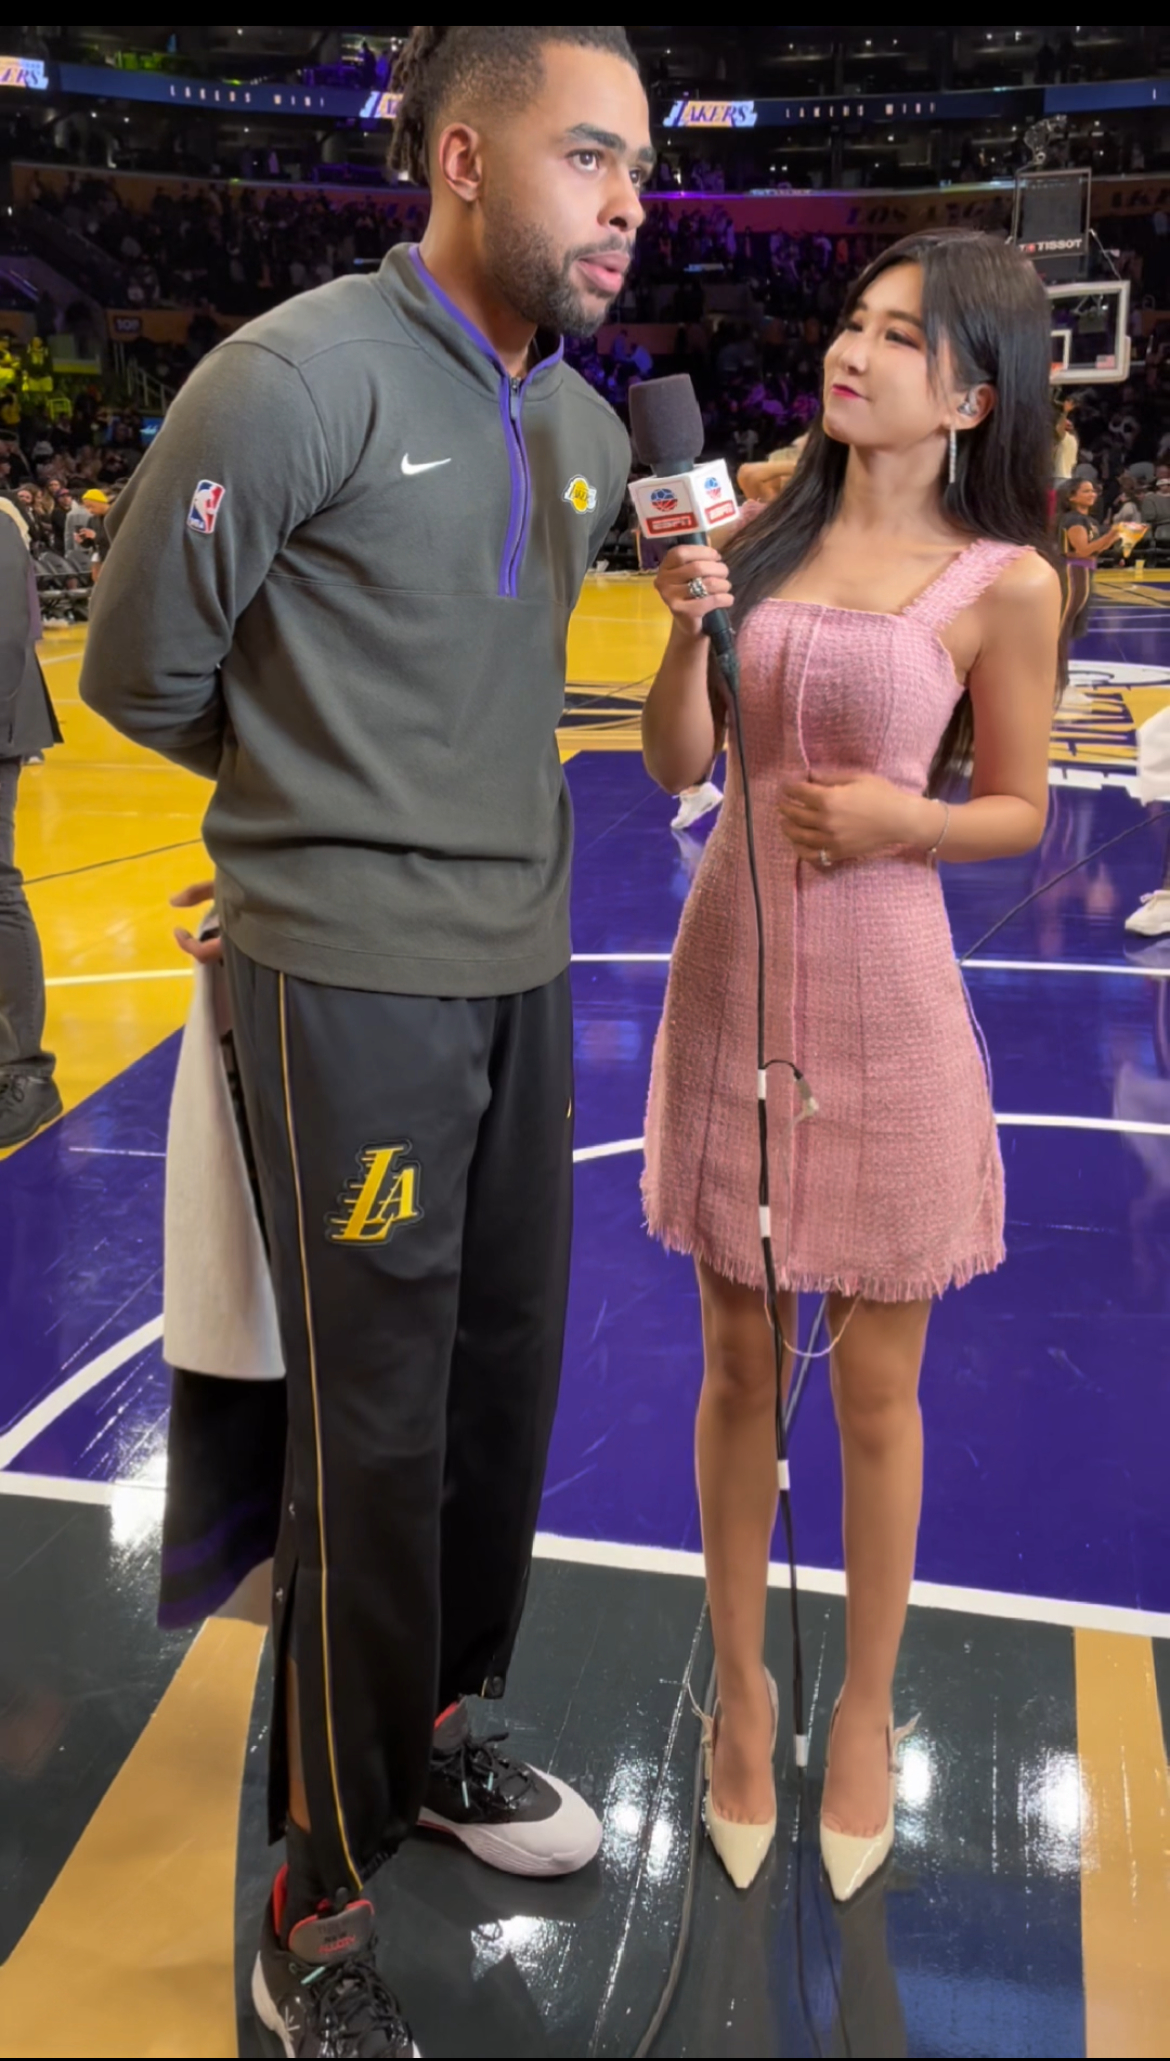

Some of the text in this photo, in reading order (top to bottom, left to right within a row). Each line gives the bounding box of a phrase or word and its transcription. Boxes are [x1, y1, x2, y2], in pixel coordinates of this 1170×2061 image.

[665, 99, 754, 127] LAKERS
[1037, 238, 1082, 252] TISSOT
[709, 501, 734, 520] ESPN
[651, 515, 692, 531] ESPN
[331, 1146, 418, 1240] LA
